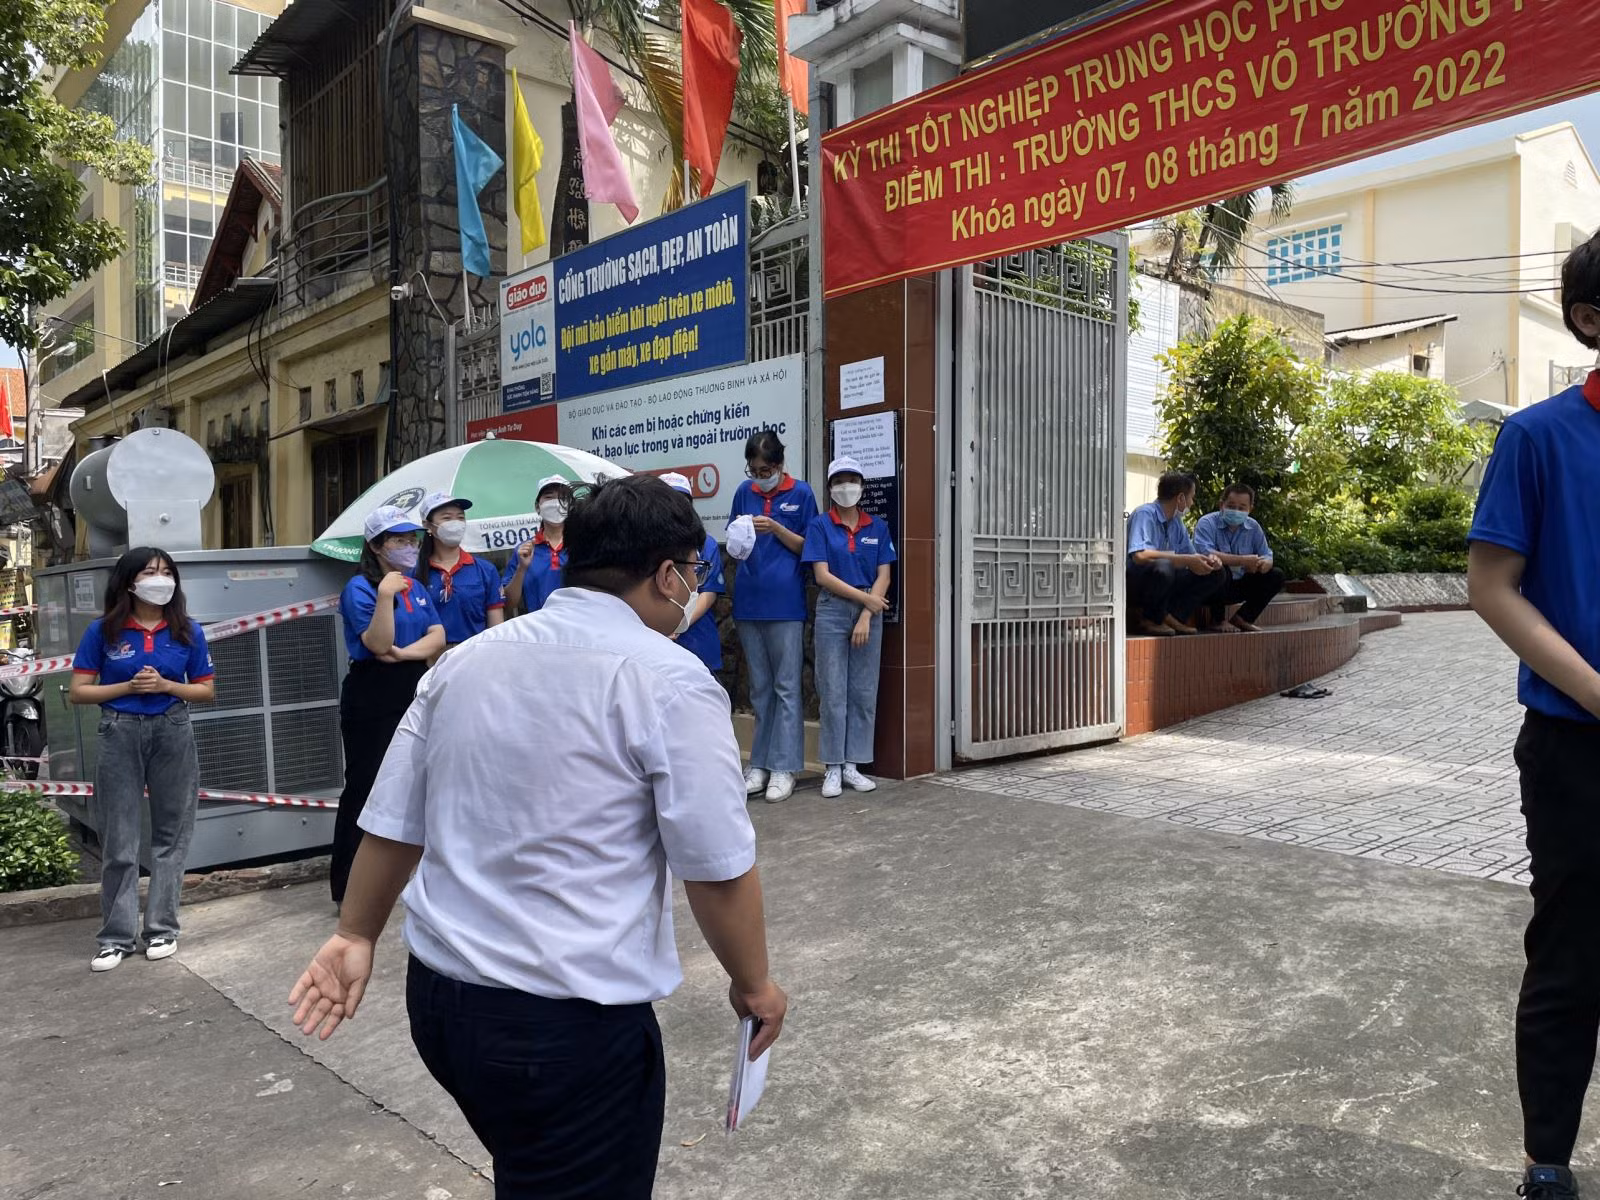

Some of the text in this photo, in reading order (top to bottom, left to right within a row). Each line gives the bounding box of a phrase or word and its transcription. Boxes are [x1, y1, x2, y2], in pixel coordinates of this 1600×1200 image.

[833, 140, 861, 184] KỲ
[866, 131, 901, 172] THI
[905, 112, 953, 158] TỐT
[959, 73, 1059, 142] NGHIỆP
[1064, 33, 1173, 103] TRUNG
[1179, 1, 1257, 63] HỌC
[884, 165, 943, 213] ĐIỂM
[950, 151, 991, 193] THI
[1013, 102, 1140, 174] TRƯỜNG
[1148, 69, 1236, 131] THCS
[1245, 37, 1297, 99] VÕ
[1308, 0, 1492, 79] TRƯỜNG
[951, 41, 1506, 241] Khóa ngày 07, 08 tháng 7 năm 2022
[558, 213, 738, 304] CỔNG TRƯỜNG SẠCH, ĐẸP, AN TOÀN
[508, 281, 546, 307] giáo dục
[575, 319, 589, 346] mũ
[590, 313, 606, 343] bảo
[606, 306, 629, 338] hiểm
[630, 303, 645, 331] khi
[646, 295, 667, 328] ngồi
[669, 292, 690, 320] trên
[691, 290, 704, 314] xe
[705, 276, 736, 311] môtô,
[510, 318, 547, 362] yola
[589, 324, 698, 376] xe gắn máy, xe đạp điện!
[658, 392, 671, 402] LAO
[695, 382, 725, 396] THƯƠNG
[727, 378, 745, 390] BINH
[773, 368, 787, 382] HỘI
[592, 401, 750, 440] Khi các em bị hoặc chứng kiến
[604, 444, 622, 460] bạo
[625, 442, 640, 458] lực
[642, 439, 669, 453] trong
[671, 434, 683, 449] và
[686, 428, 717, 449] ngoài
